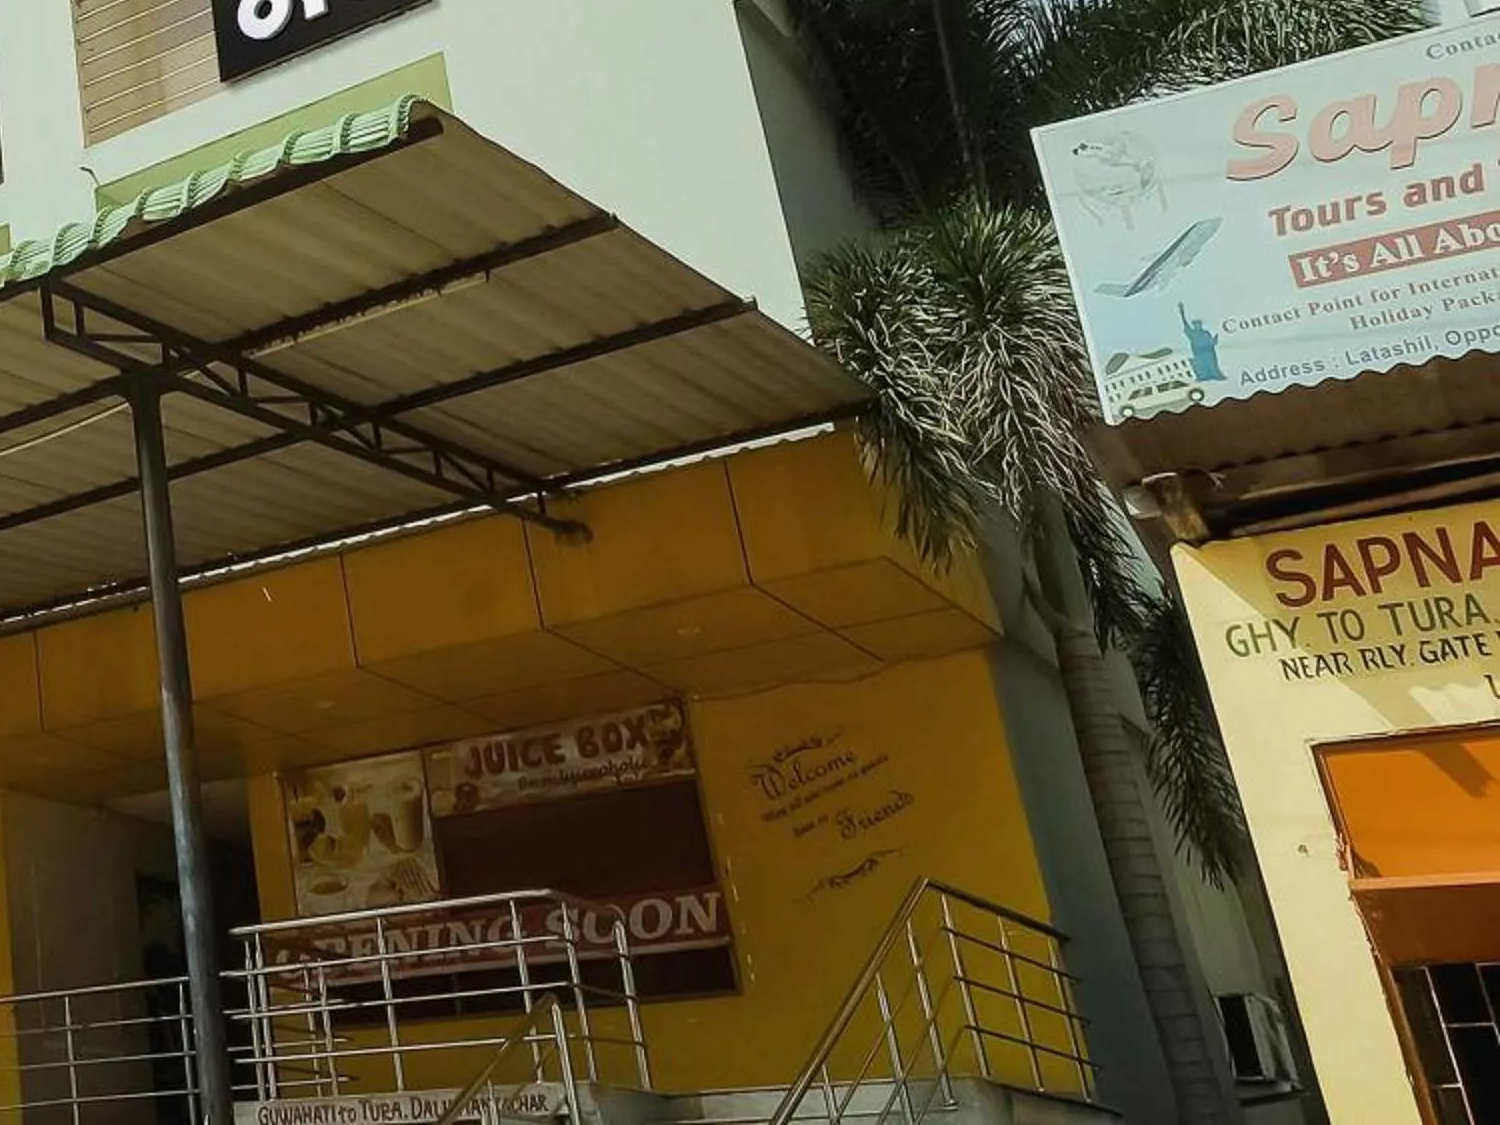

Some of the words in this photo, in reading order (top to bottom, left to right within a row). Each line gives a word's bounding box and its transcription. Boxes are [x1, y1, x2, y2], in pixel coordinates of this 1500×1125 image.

[1426, 34, 1500, 60] Conta
[1268, 191, 1387, 237] Tours
[1403, 163, 1485, 208] and
[1371, 234, 1425, 268] All
[1221, 308, 1301, 334] Contact
[1308, 293, 1364, 316] Point
[1371, 286, 1401, 304] for
[1350, 305, 1434, 331] Holiday
[1442, 289, 1500, 312] Pack
[1240, 357, 1325, 386] Address
[1265, 520, 1500, 608] SAPNA
[1316, 608, 1366, 644] TO
[1280, 652, 1353, 681] NEAR
[1419, 632, 1493, 665] GATE
[464, 733, 566, 780] JUICE
[576, 712, 651, 759] BOX
[750, 749, 856, 801] Welcome
[545, 891, 722, 950] SOON
[257, 1103, 336, 1125] GUWAHATI
